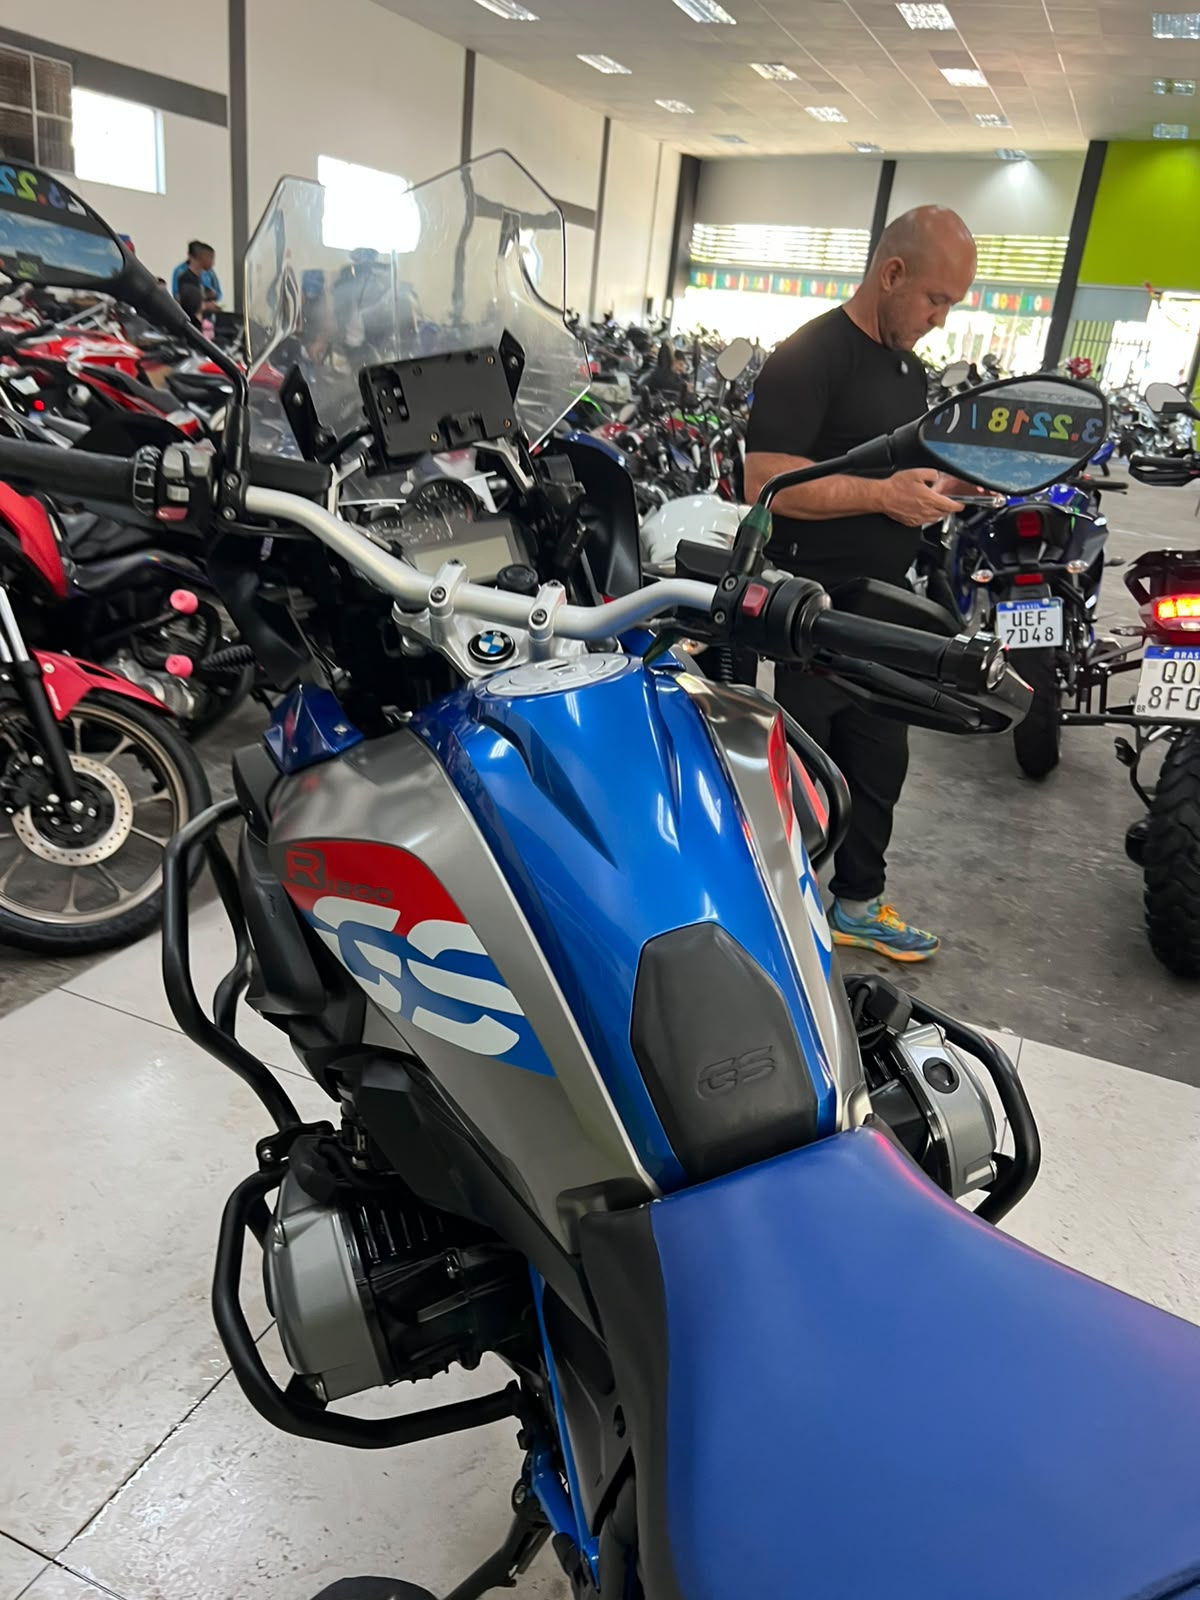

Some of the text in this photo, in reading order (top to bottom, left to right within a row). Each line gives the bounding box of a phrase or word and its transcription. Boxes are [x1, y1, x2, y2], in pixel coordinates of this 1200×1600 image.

[1012, 610, 1047, 627] UEF
[1006, 627, 1054, 644] 7D48
[1162, 661, 1200, 684] QO
[285, 849, 321, 886] R
[697, 1045, 776, 1100] GS
